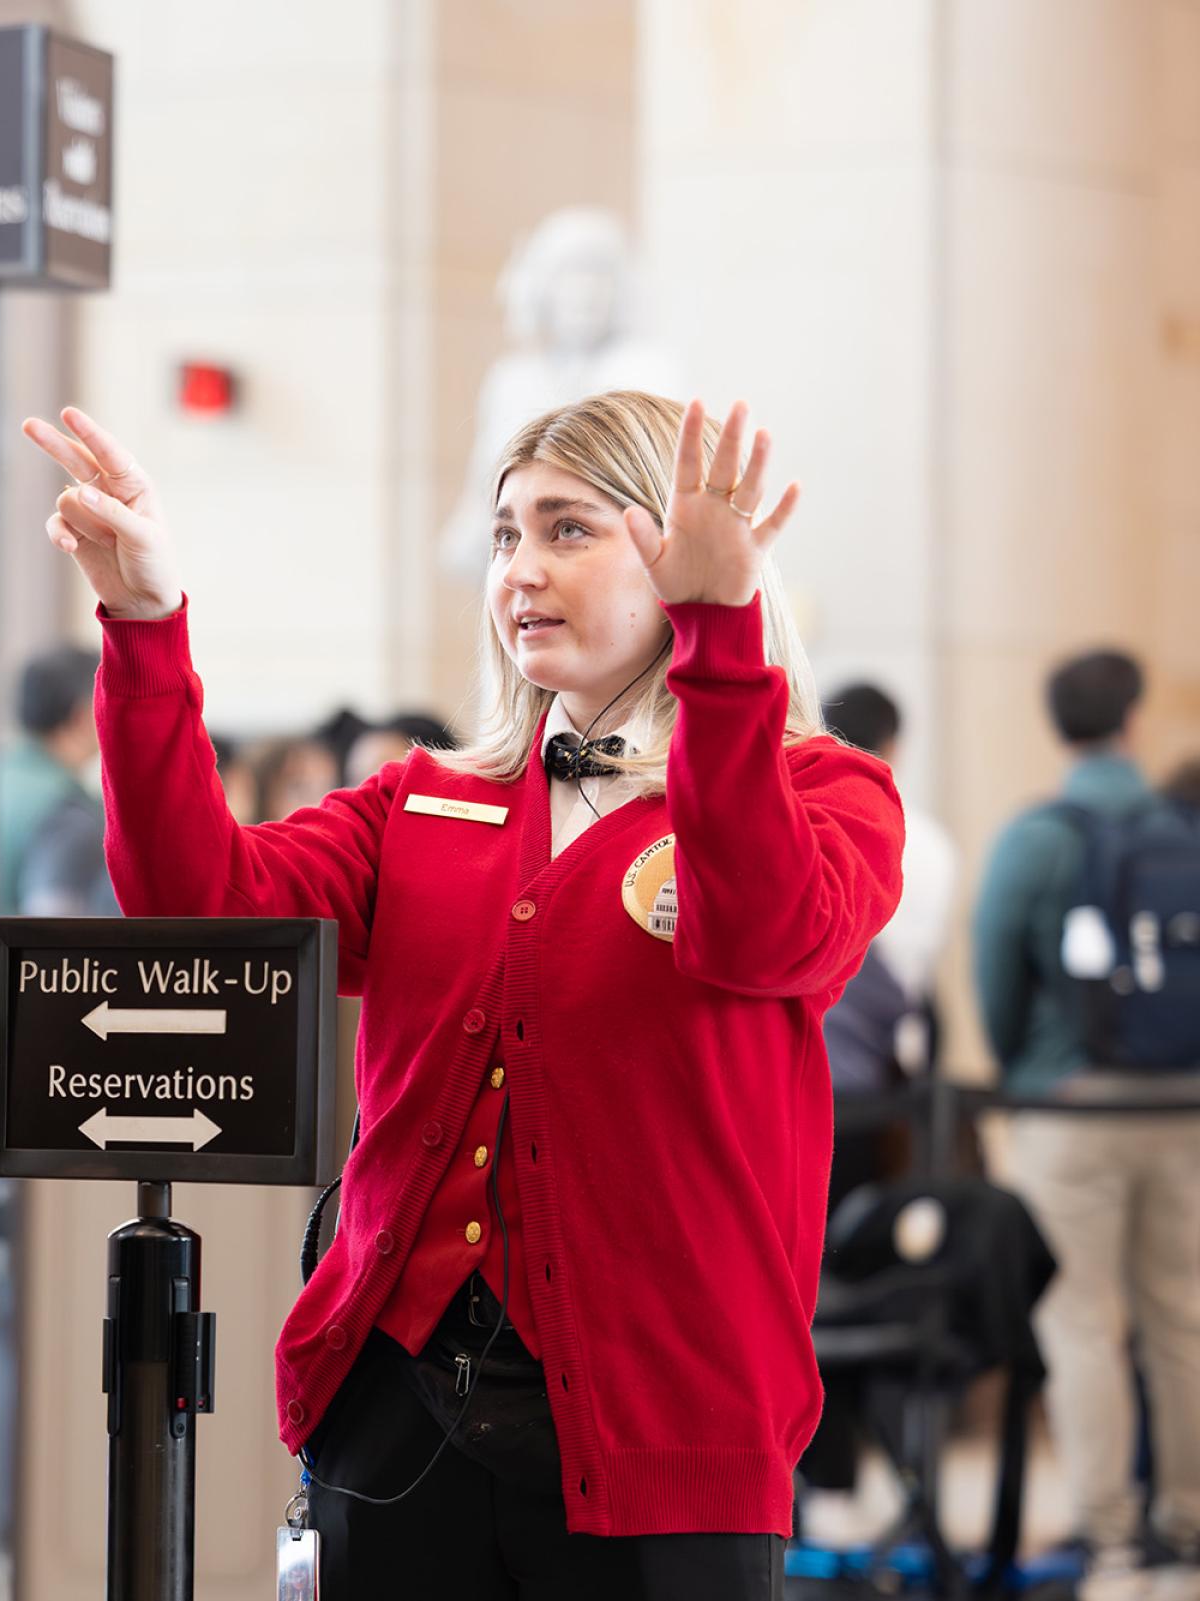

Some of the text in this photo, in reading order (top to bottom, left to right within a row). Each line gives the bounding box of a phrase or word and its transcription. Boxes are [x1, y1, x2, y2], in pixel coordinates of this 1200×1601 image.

[441, 803, 470, 815] Emma
[624, 838, 673, 888] U.S. CAPITOL
[19, 958, 292, 1004] Public Walk-Up
[49, 1065, 254, 1100] Reservations
